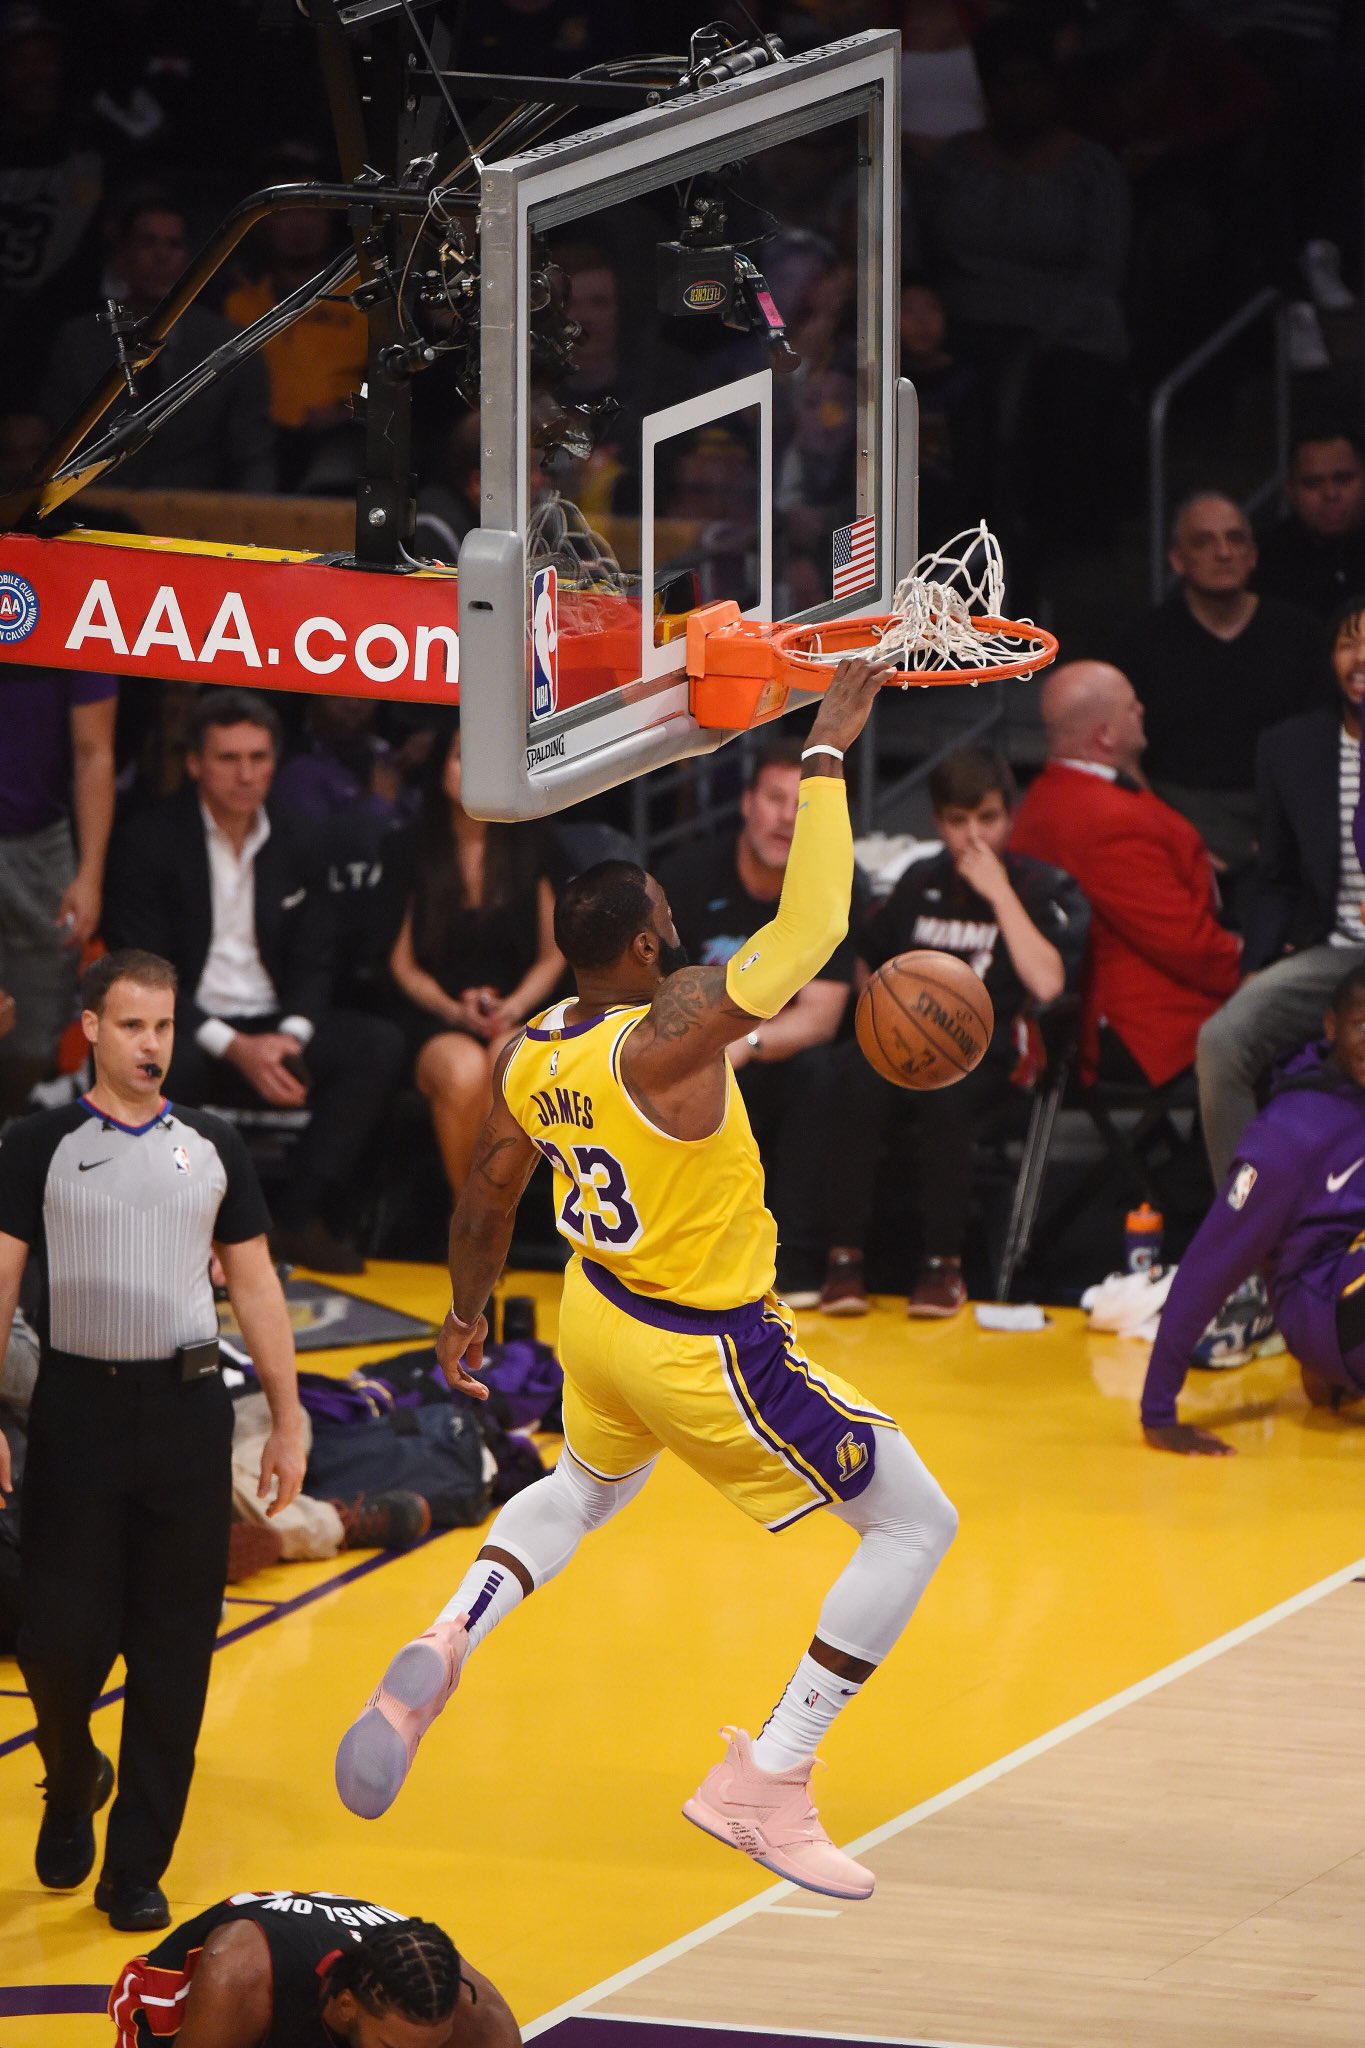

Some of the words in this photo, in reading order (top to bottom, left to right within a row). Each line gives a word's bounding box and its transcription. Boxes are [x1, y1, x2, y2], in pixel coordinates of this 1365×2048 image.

[690, 287, 721, 302] FLETCHER
[19, 582, 35, 603] CLUB
[6, 607, 37, 641] CALIFORNIA
[536, 683, 549, 710] NBA
[526, 733, 565, 771] SPALDING
[530, 1087, 594, 1129] JAMES
[530, 1136, 644, 1252] 23
